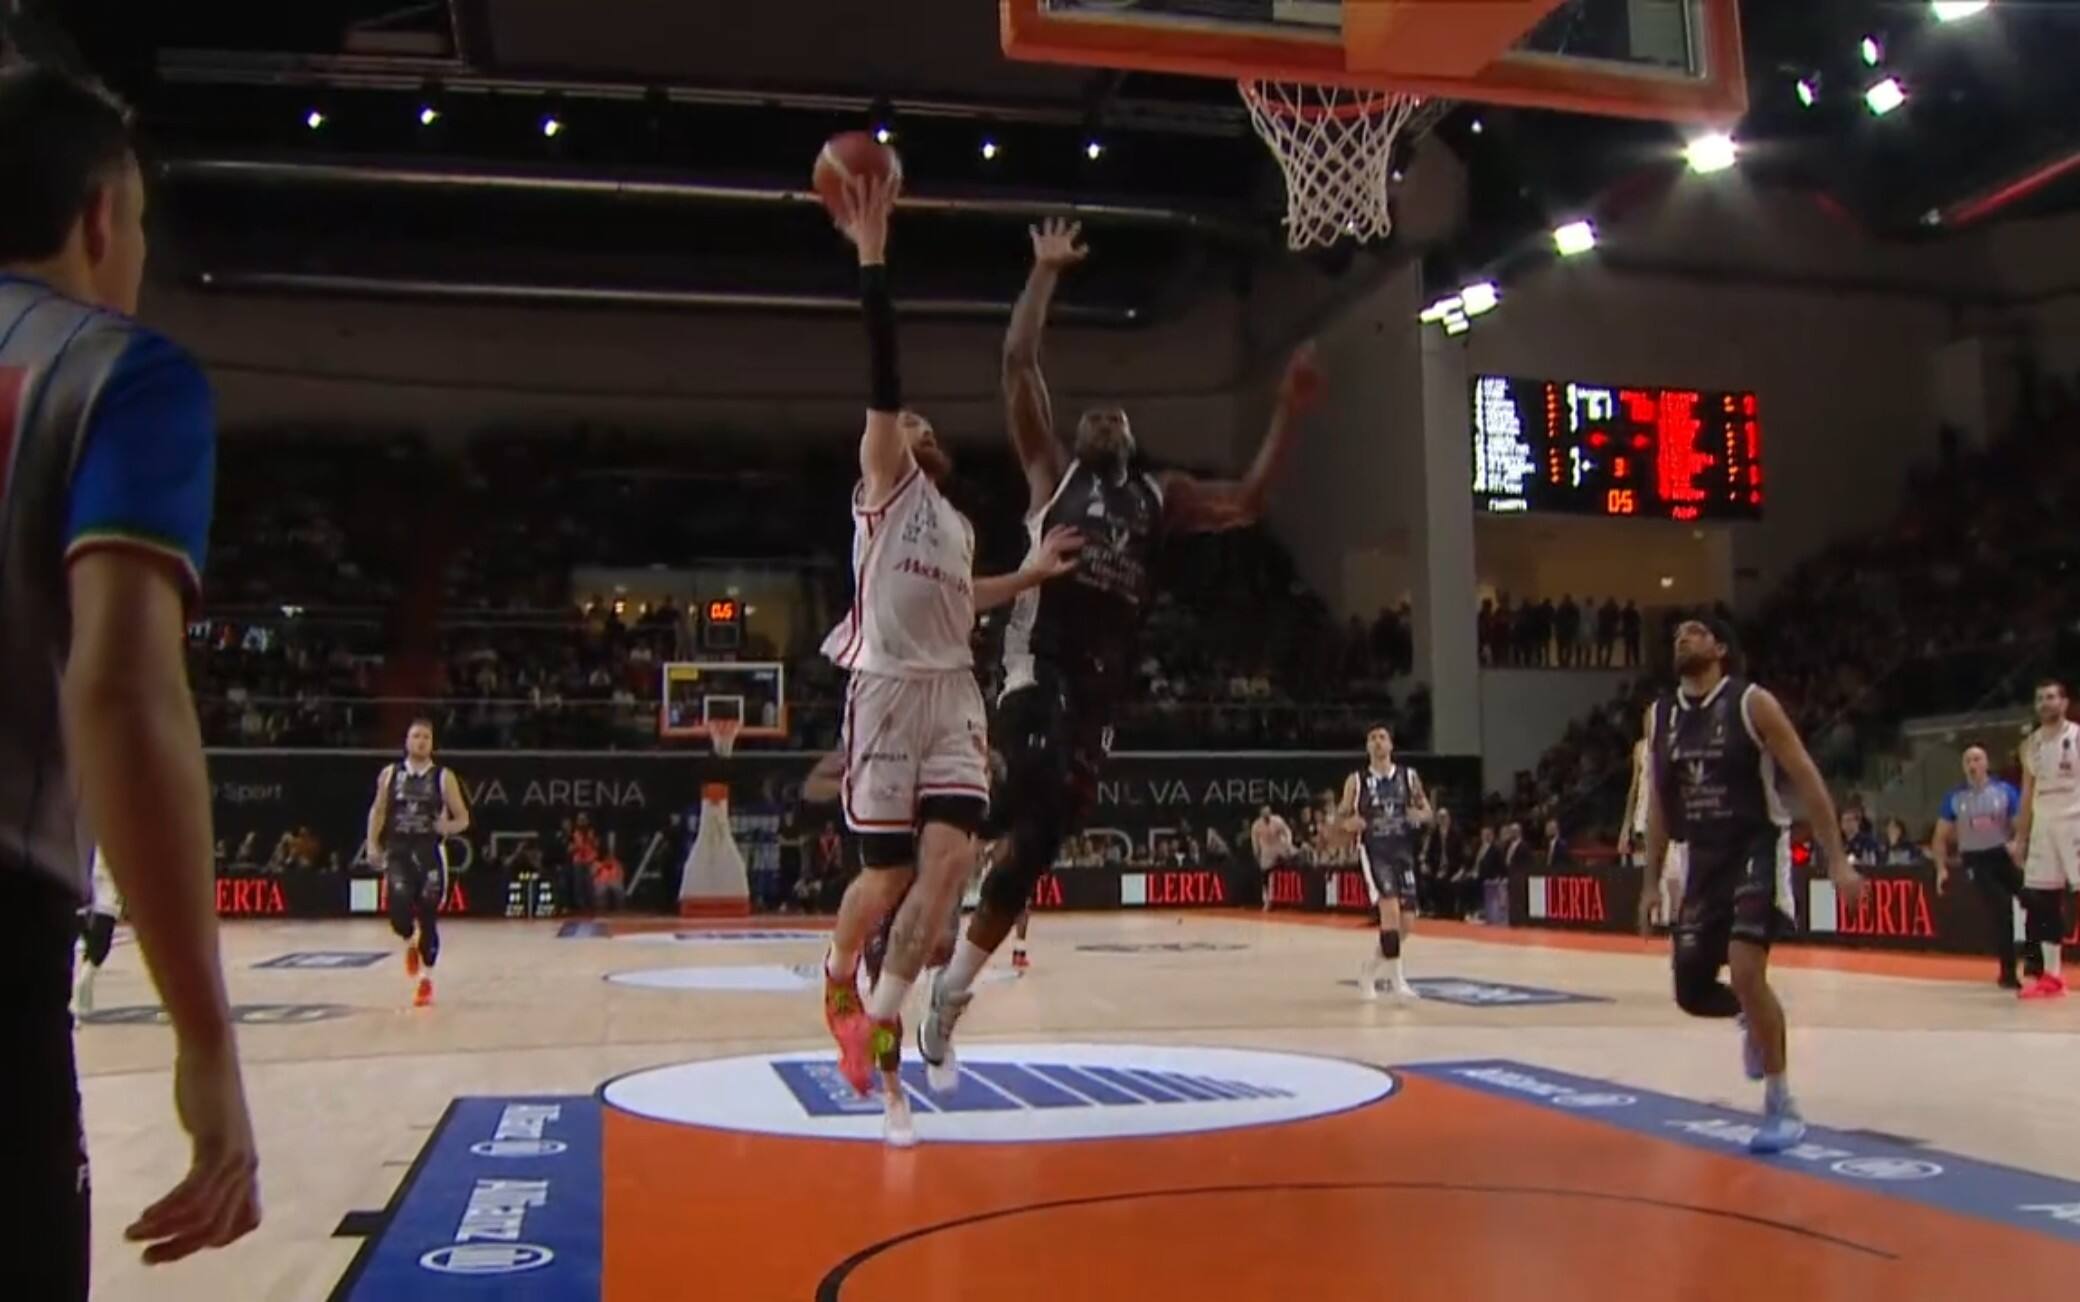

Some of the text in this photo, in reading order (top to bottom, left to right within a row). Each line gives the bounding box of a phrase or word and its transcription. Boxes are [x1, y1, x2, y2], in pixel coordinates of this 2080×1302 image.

[224, 780, 284, 805] Sport
[521, 777, 646, 808] ARENA
[1202, 777, 1312, 804] ARENA
[215, 877, 286, 914] ERTA
[1146, 867, 1224, 903] LERTA
[1546, 875, 1607, 921] LERTA
[1837, 877, 1936, 938] LERTA
